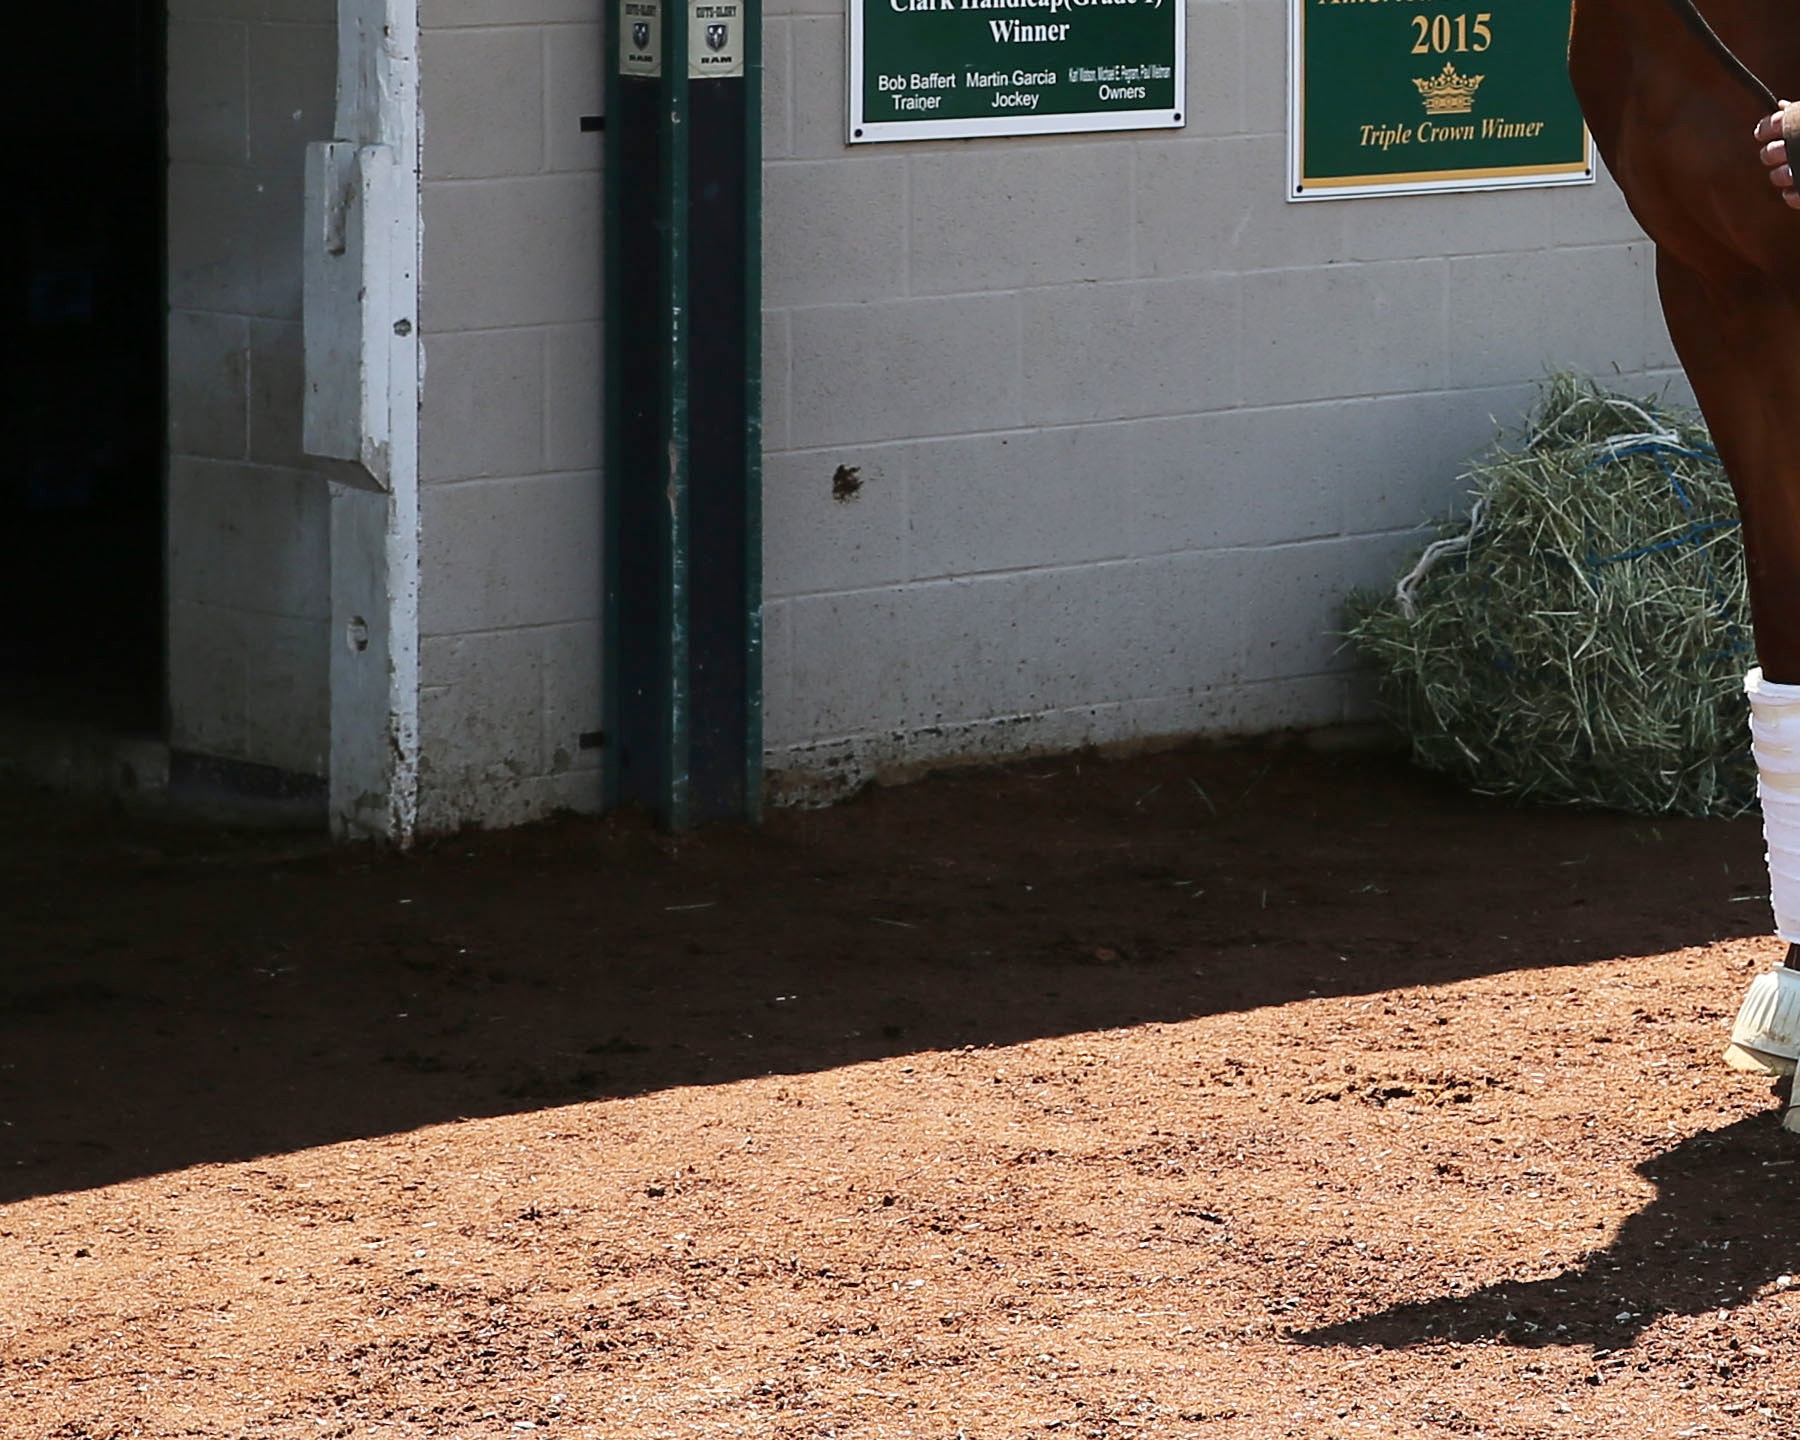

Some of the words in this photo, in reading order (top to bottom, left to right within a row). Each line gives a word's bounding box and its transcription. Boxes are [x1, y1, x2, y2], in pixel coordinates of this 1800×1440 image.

[989, 19, 1070, 43] Winner
[1410, 13, 1493, 55] 2015
[629, 54, 653, 62] RAM
[701, 56, 732, 64] RAM
[878, 74, 907, 91] Bob
[910, 72, 956, 89] Baffert
[966, 71, 1009, 87] Martin
[1012, 69, 1057, 86] Garcia
[991, 92, 1039, 109] Jockey
[1098, 84, 1146, 101] Owners
[891, 94, 942, 111] Trainer
[1360, 124, 1412, 151] Triple
[1416, 119, 1475, 143] Crown
[1481, 118, 1544, 140] Winner
